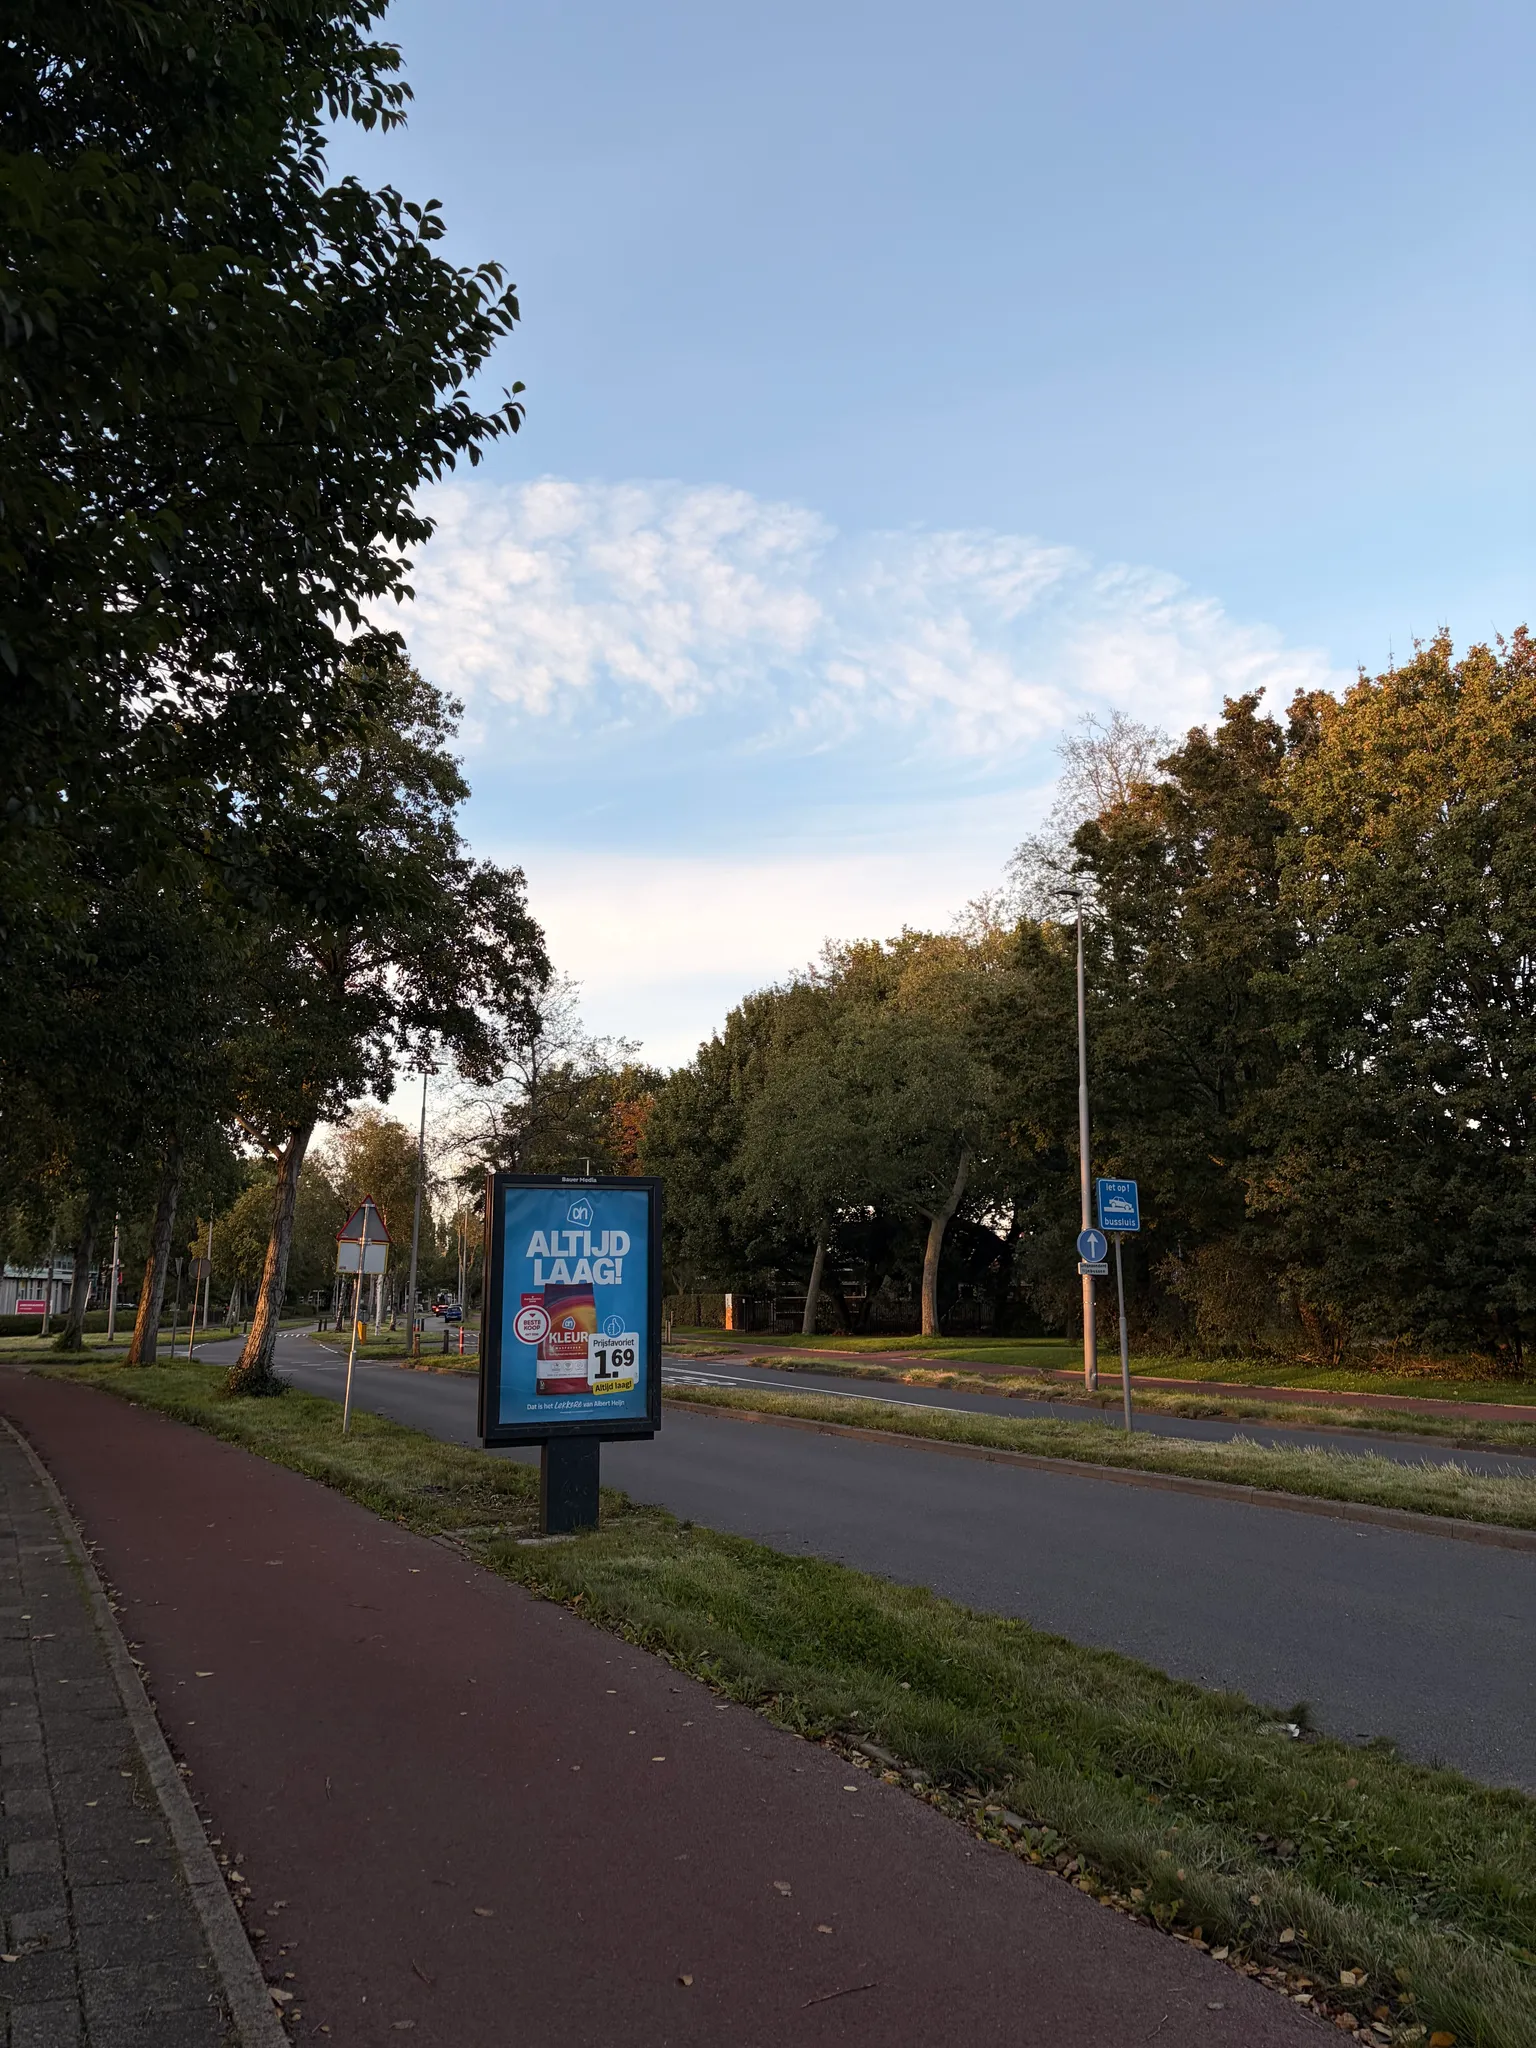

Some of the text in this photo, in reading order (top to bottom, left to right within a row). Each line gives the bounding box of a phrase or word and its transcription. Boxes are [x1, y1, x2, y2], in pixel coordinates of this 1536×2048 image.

[1105, 1182, 1130, 1194] let op!
[1104, 1217, 1136, 1227] bussluis
[525, 1230, 631, 1258] ALTIJD
[533, 1258, 623, 1286] LAAG!
[549, 1332, 589, 1344] KLEUR
[593, 1338, 635, 1348] Prijsfavoriet
[595, 1380, 632, 1392] Altijd laag!
[543, 1402, 553, 1410] het
[611, 1399, 625, 1407] Heijn
